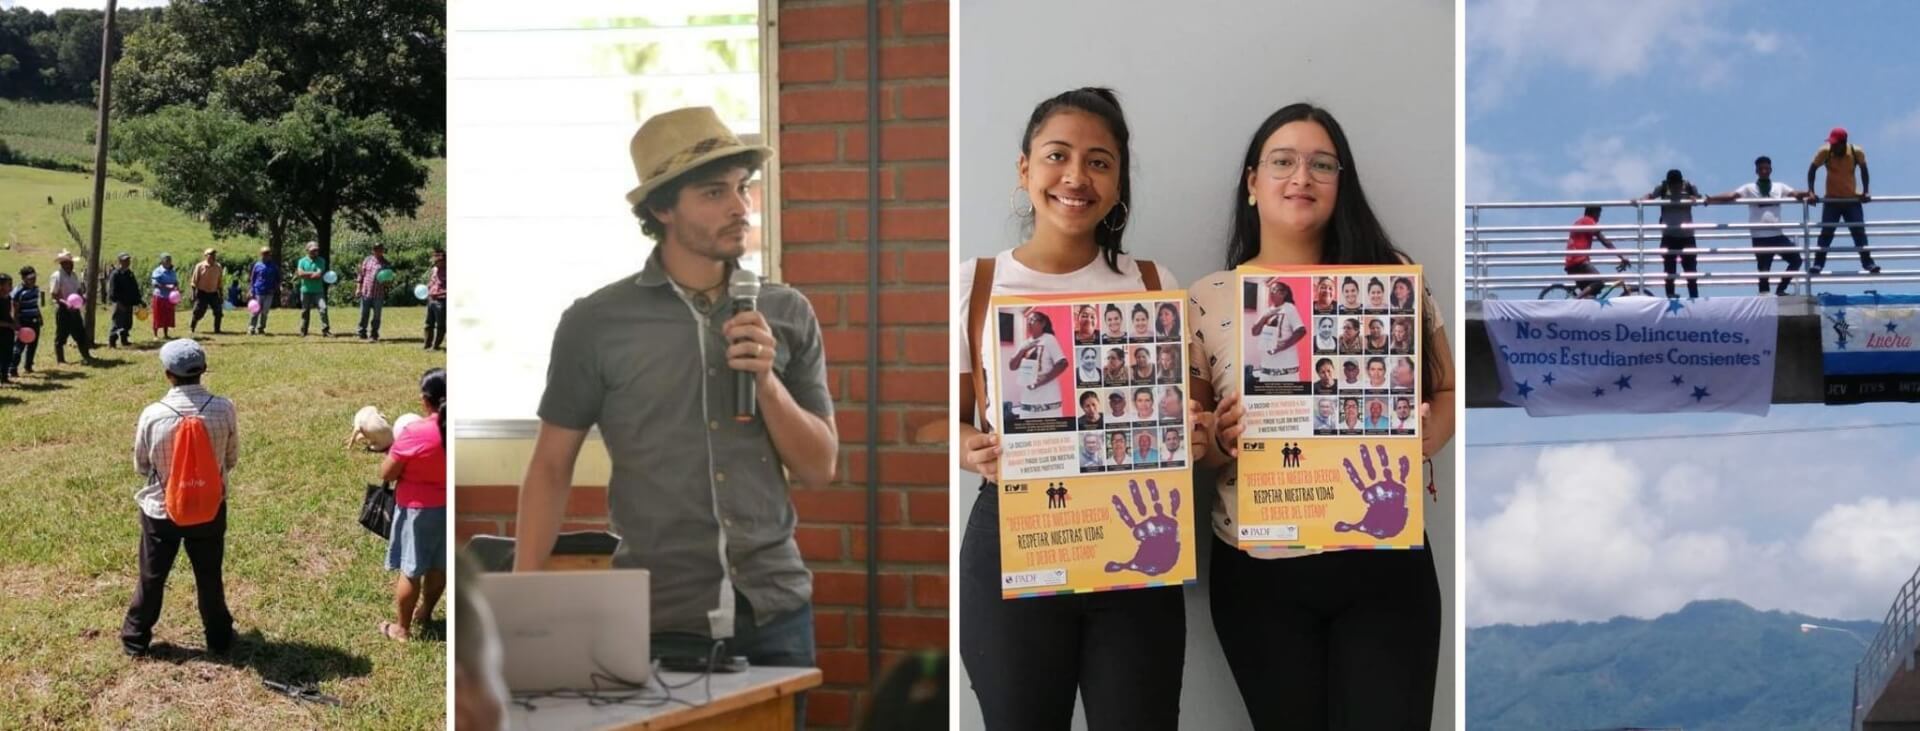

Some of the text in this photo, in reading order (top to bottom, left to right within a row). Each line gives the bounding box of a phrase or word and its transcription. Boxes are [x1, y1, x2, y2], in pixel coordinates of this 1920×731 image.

[1546, 323, 1611, 342] Somos
[1615, 323, 1750, 344] Delincuentes,
[1866, 332, 1912, 348] Lucha
[1560, 346, 1664, 367] Estudiantes
[1253, 486, 1335, 504] RESPETAR NUESTRAS VIDAS
[1017, 525, 1104, 550] RESPETAR NUESTRAS VIDAS
